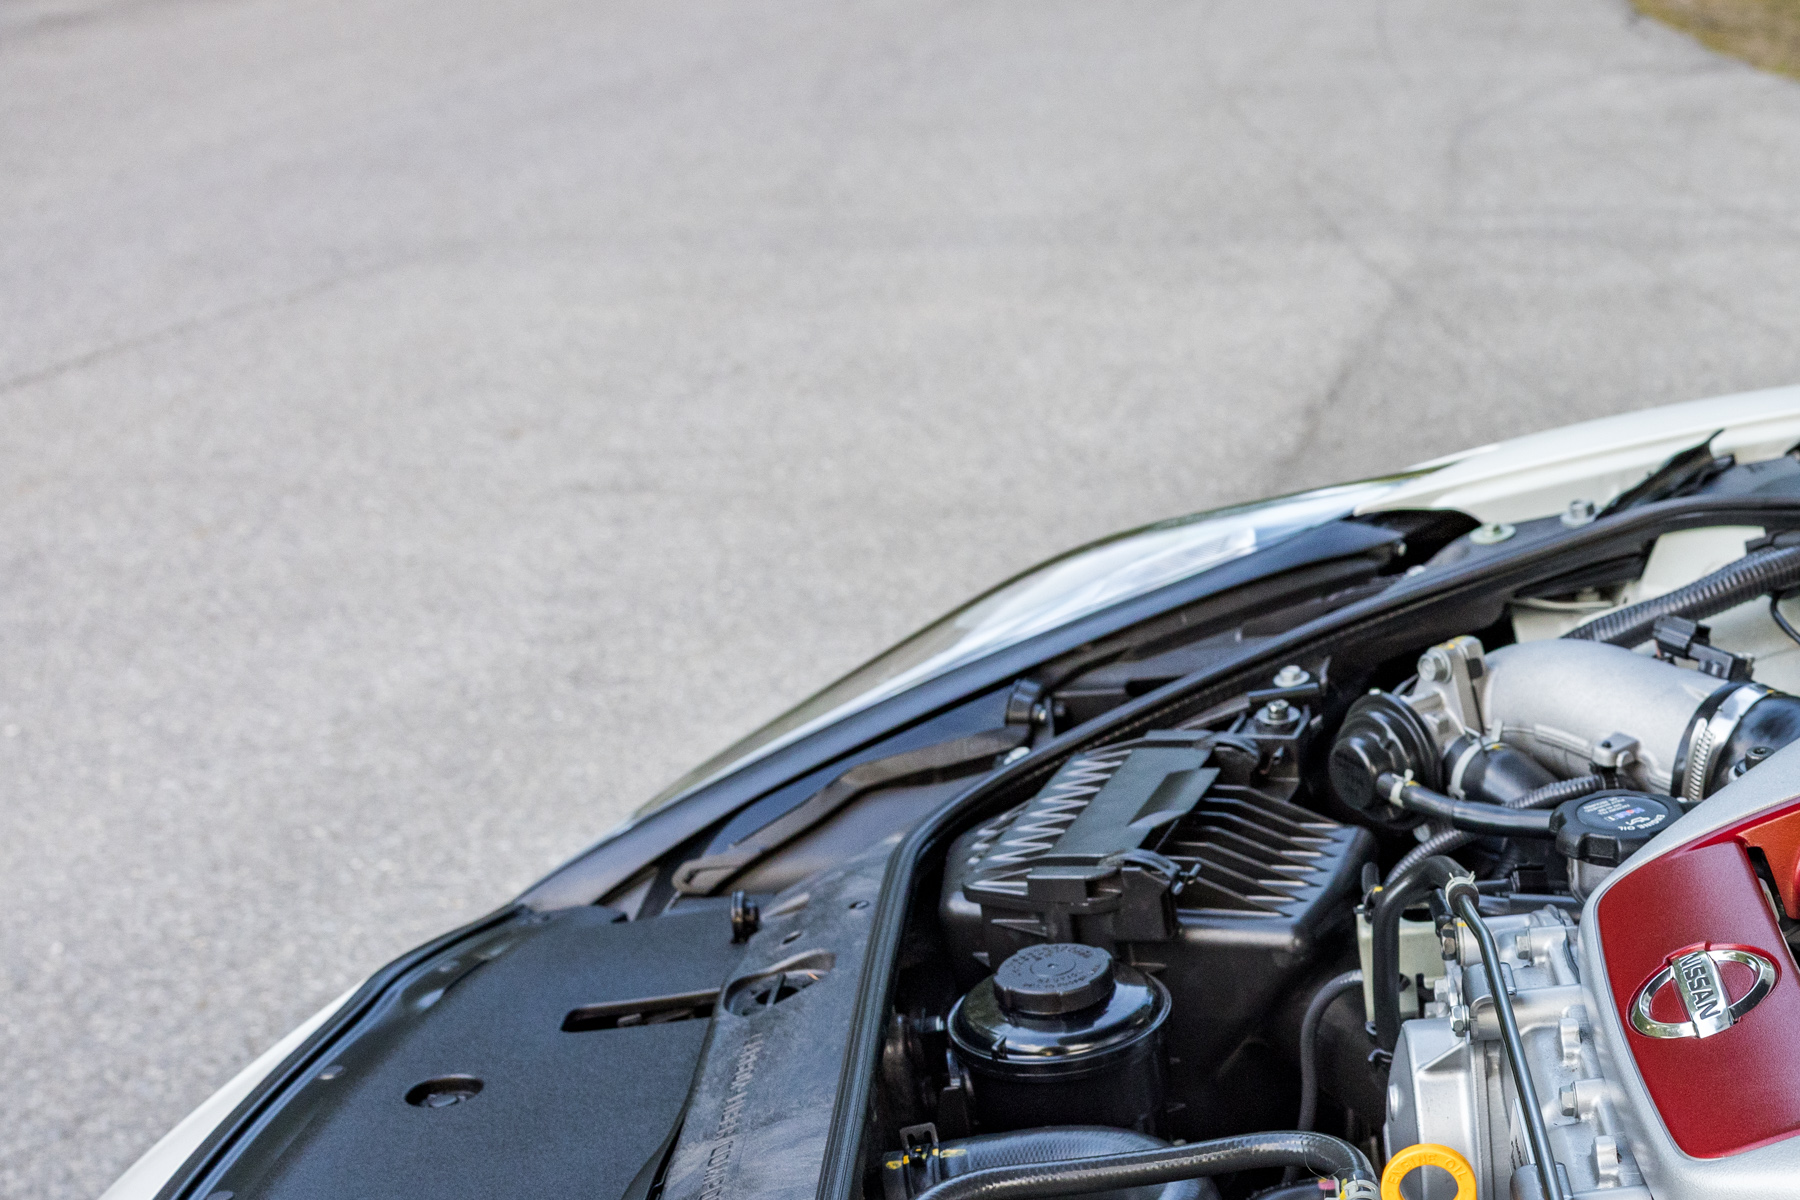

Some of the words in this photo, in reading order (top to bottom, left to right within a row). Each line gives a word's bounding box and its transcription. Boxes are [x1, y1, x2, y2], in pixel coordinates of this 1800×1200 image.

[1678, 951, 1721, 1020] NISSAN
[1388, 1154, 1437, 1185] ENGINE
[1446, 1158, 1467, 1181] OIL
